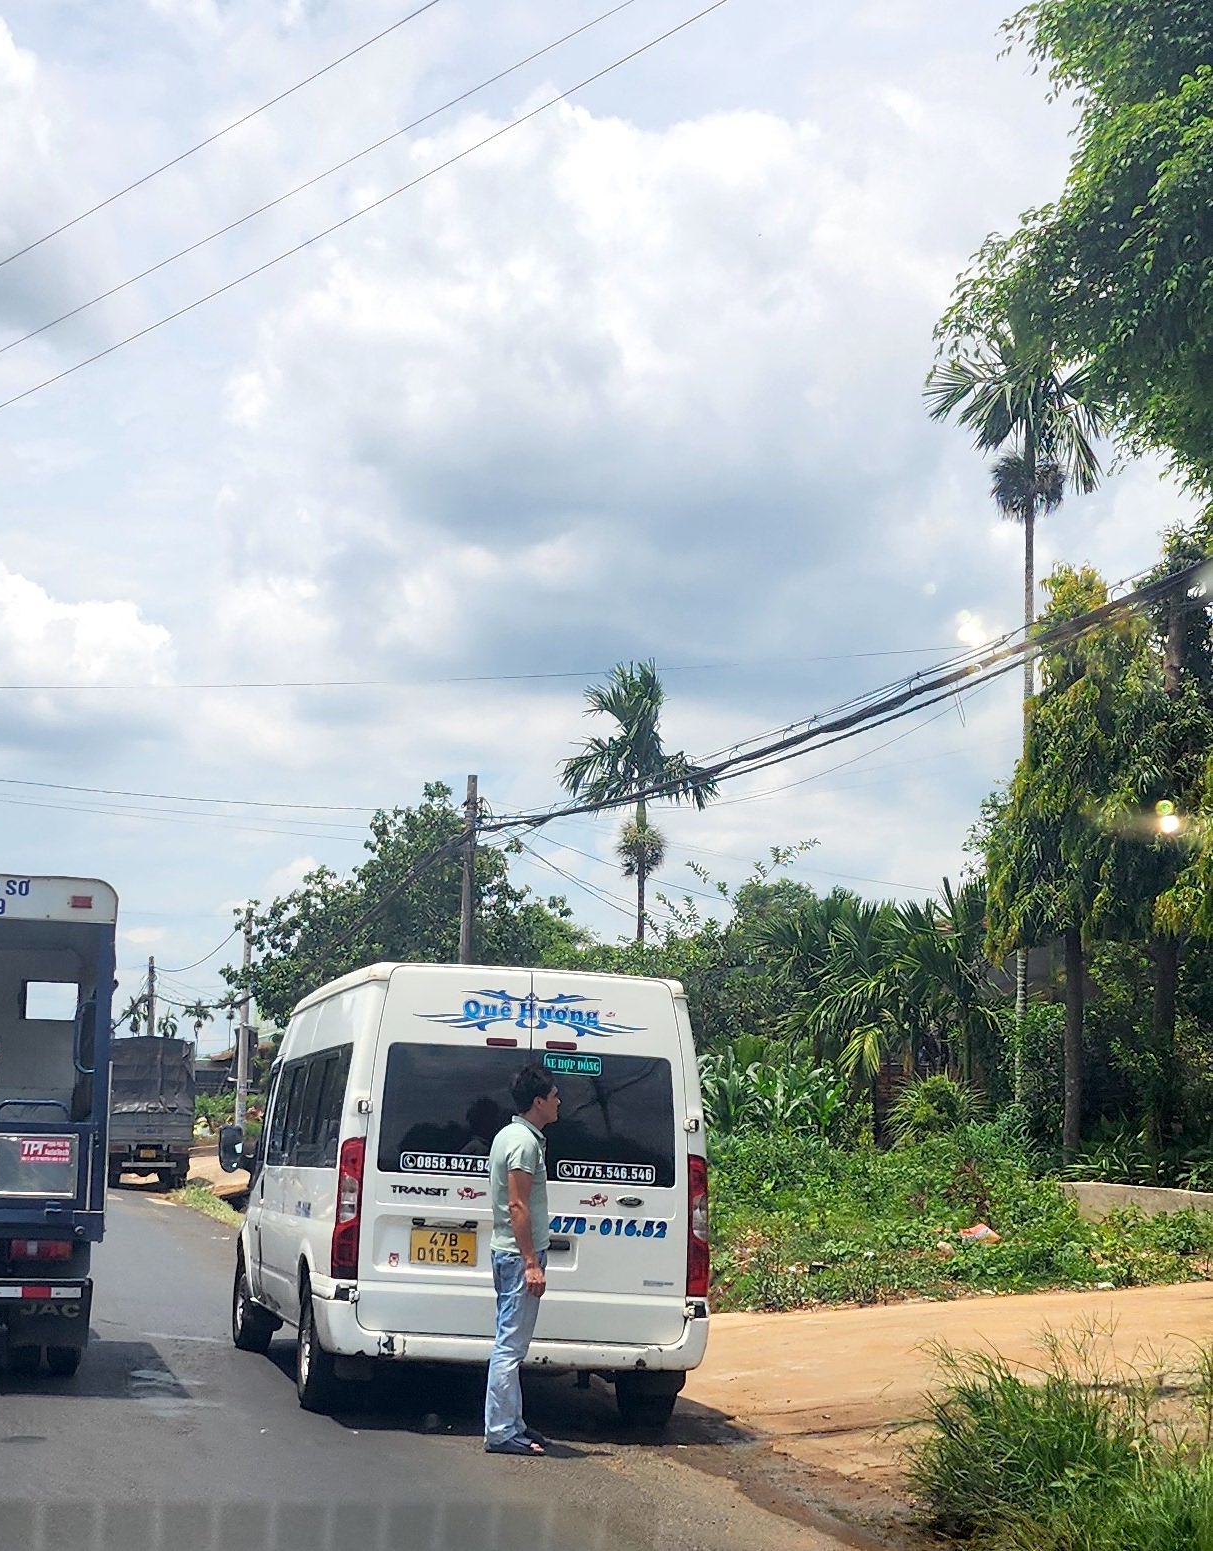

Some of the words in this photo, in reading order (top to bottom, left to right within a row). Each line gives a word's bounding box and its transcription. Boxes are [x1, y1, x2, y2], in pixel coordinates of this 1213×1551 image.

[5, 879, 31, 896] SƠ
[463, 998, 513, 1019] Quê
[519, 1001, 600, 1027] Hương
[416, 1156, 491, 1172] 0858.947.94
[391, 1185, 449, 1197] TRANSIT
[549, 1216, 587, 1235] 47B
[599, 1218, 668, 1239] 016.52
[429, 1231, 458, 1247] 47B
[417, 1247, 469, 1263] 016.52
[20, 1303, 80, 1318] JAC
